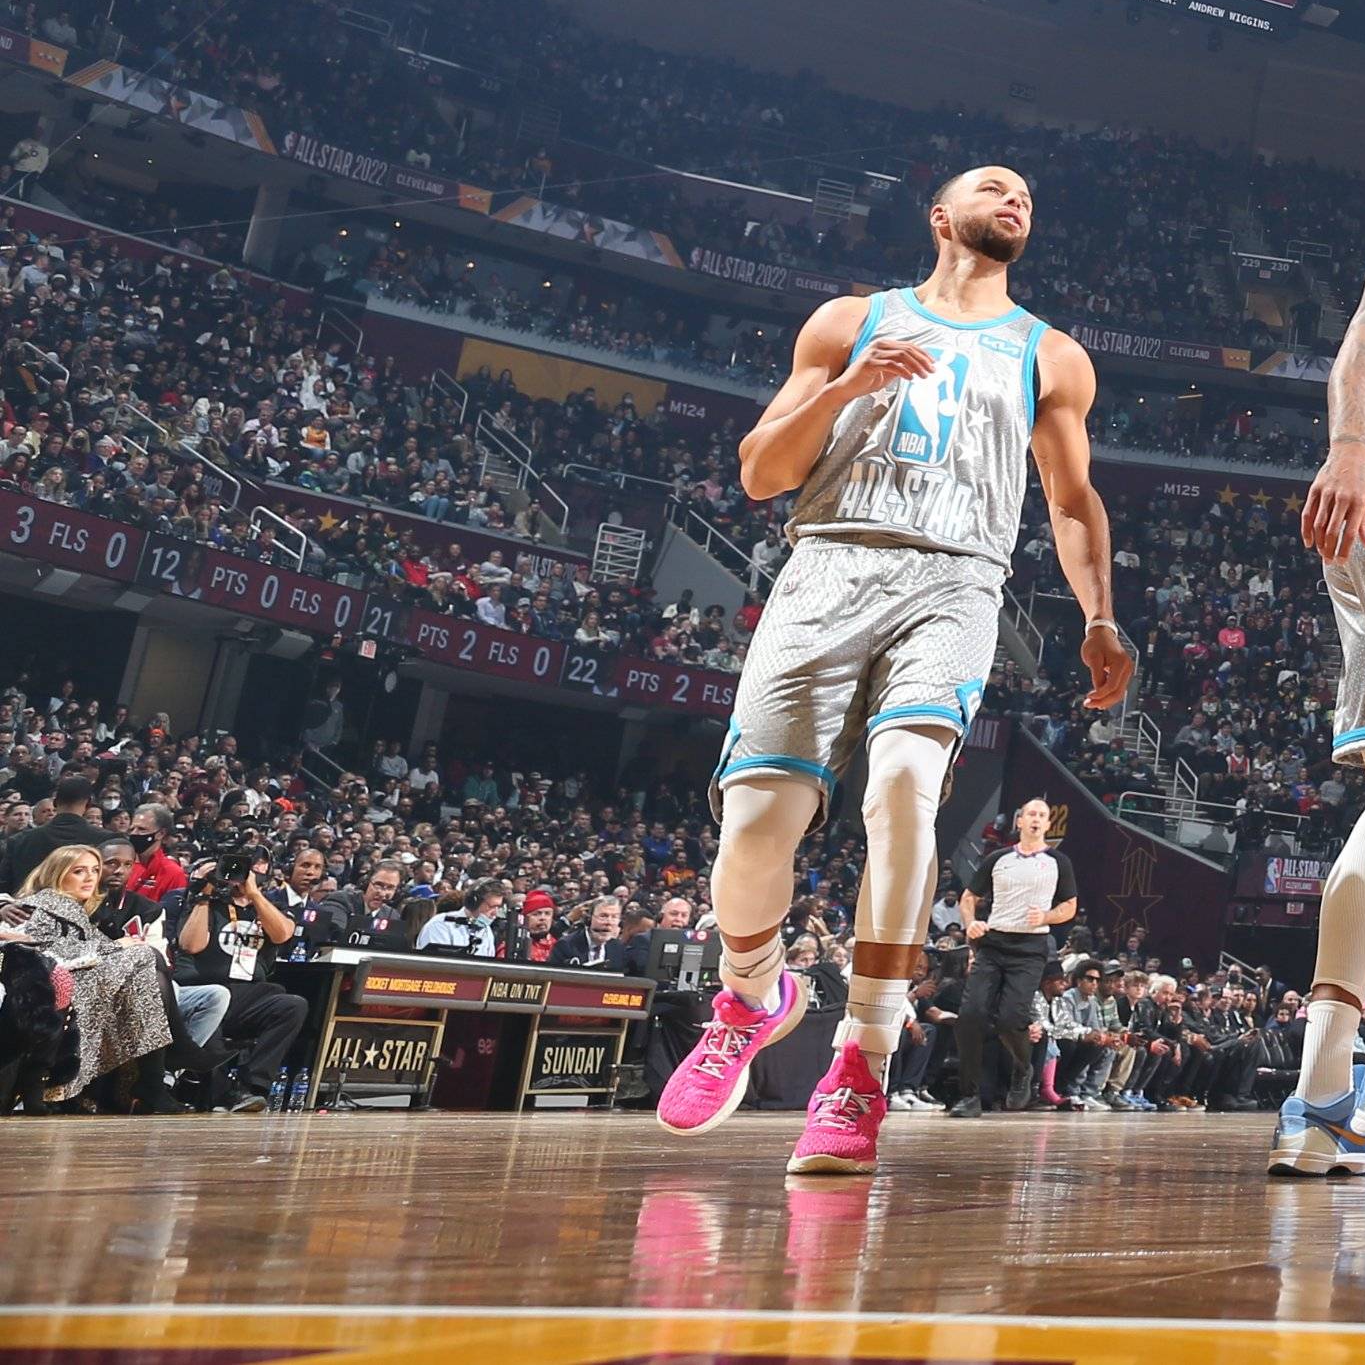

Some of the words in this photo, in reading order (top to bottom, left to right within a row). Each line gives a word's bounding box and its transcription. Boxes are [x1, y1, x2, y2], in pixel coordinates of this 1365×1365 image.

[1188, 1, 1225, 18] ANDREW
[1229, 11, 1274, 31] WIGGINS.
[352, 155, 388, 187] 2022
[396, 173, 445, 196] CLEVELAND
[754, 264, 788, 291] 2022
[795, 277, 840, 295] CLEVELAND
[1134, 336, 1161, 359] 2022
[1169, 345, 1211, 361] CLEVELAND
[669, 399, 706, 418] M124
[897, 432, 927, 456] NBA
[837, 461, 975, 543] ALL-STAR
[1163, 482, 1200, 497] M125
[10, 506, 35, 544] 3
[49, 521, 89, 554] FLS
[105, 532, 127, 569] 0
[151, 547, 182, 581] 12
[210, 566, 249, 596] PTS
[260, 575, 279, 609] 0
[289, 588, 322, 615] FLS
[334, 595, 351, 629] 0
[366, 606, 393, 636] 21
[417, 623, 450, 650] PTS
[458, 630, 477, 661] 2
[488, 641, 520, 666] FLS
[533, 646, 550, 677] 0
[568, 655, 598, 684] 22
[626, 669, 660, 693] PTS
[672, 674, 690, 703] 2
[702, 684, 734, 707] FLS
[1282, 858, 1320, 879] ALL-STAR
[490, 982, 509, 998] NBA
[510, 983, 524, 998] ON
[524, 984, 542, 1000] TNT
[542, 1046, 605, 1074] SUNDAY
